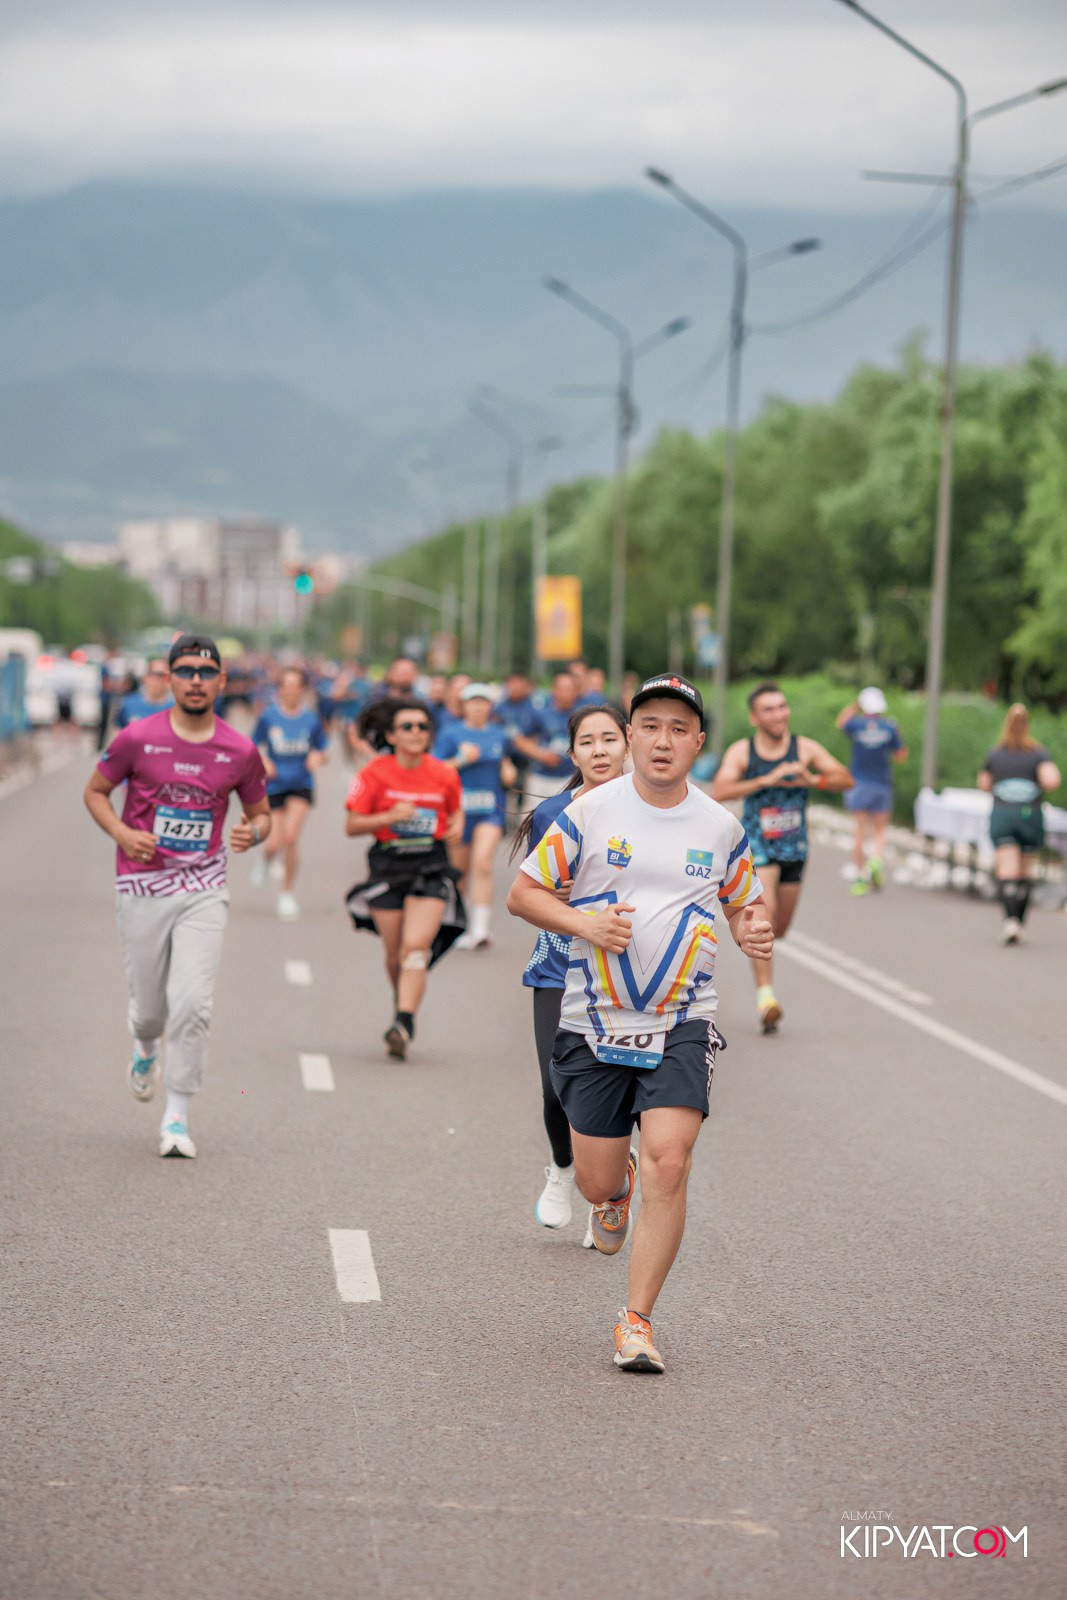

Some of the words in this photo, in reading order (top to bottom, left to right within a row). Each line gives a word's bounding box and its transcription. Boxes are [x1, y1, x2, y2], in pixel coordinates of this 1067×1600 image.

[163, 821, 205, 838] 1473
[609, 852, 620, 860] BI
[685, 864, 712, 879] QAZ
